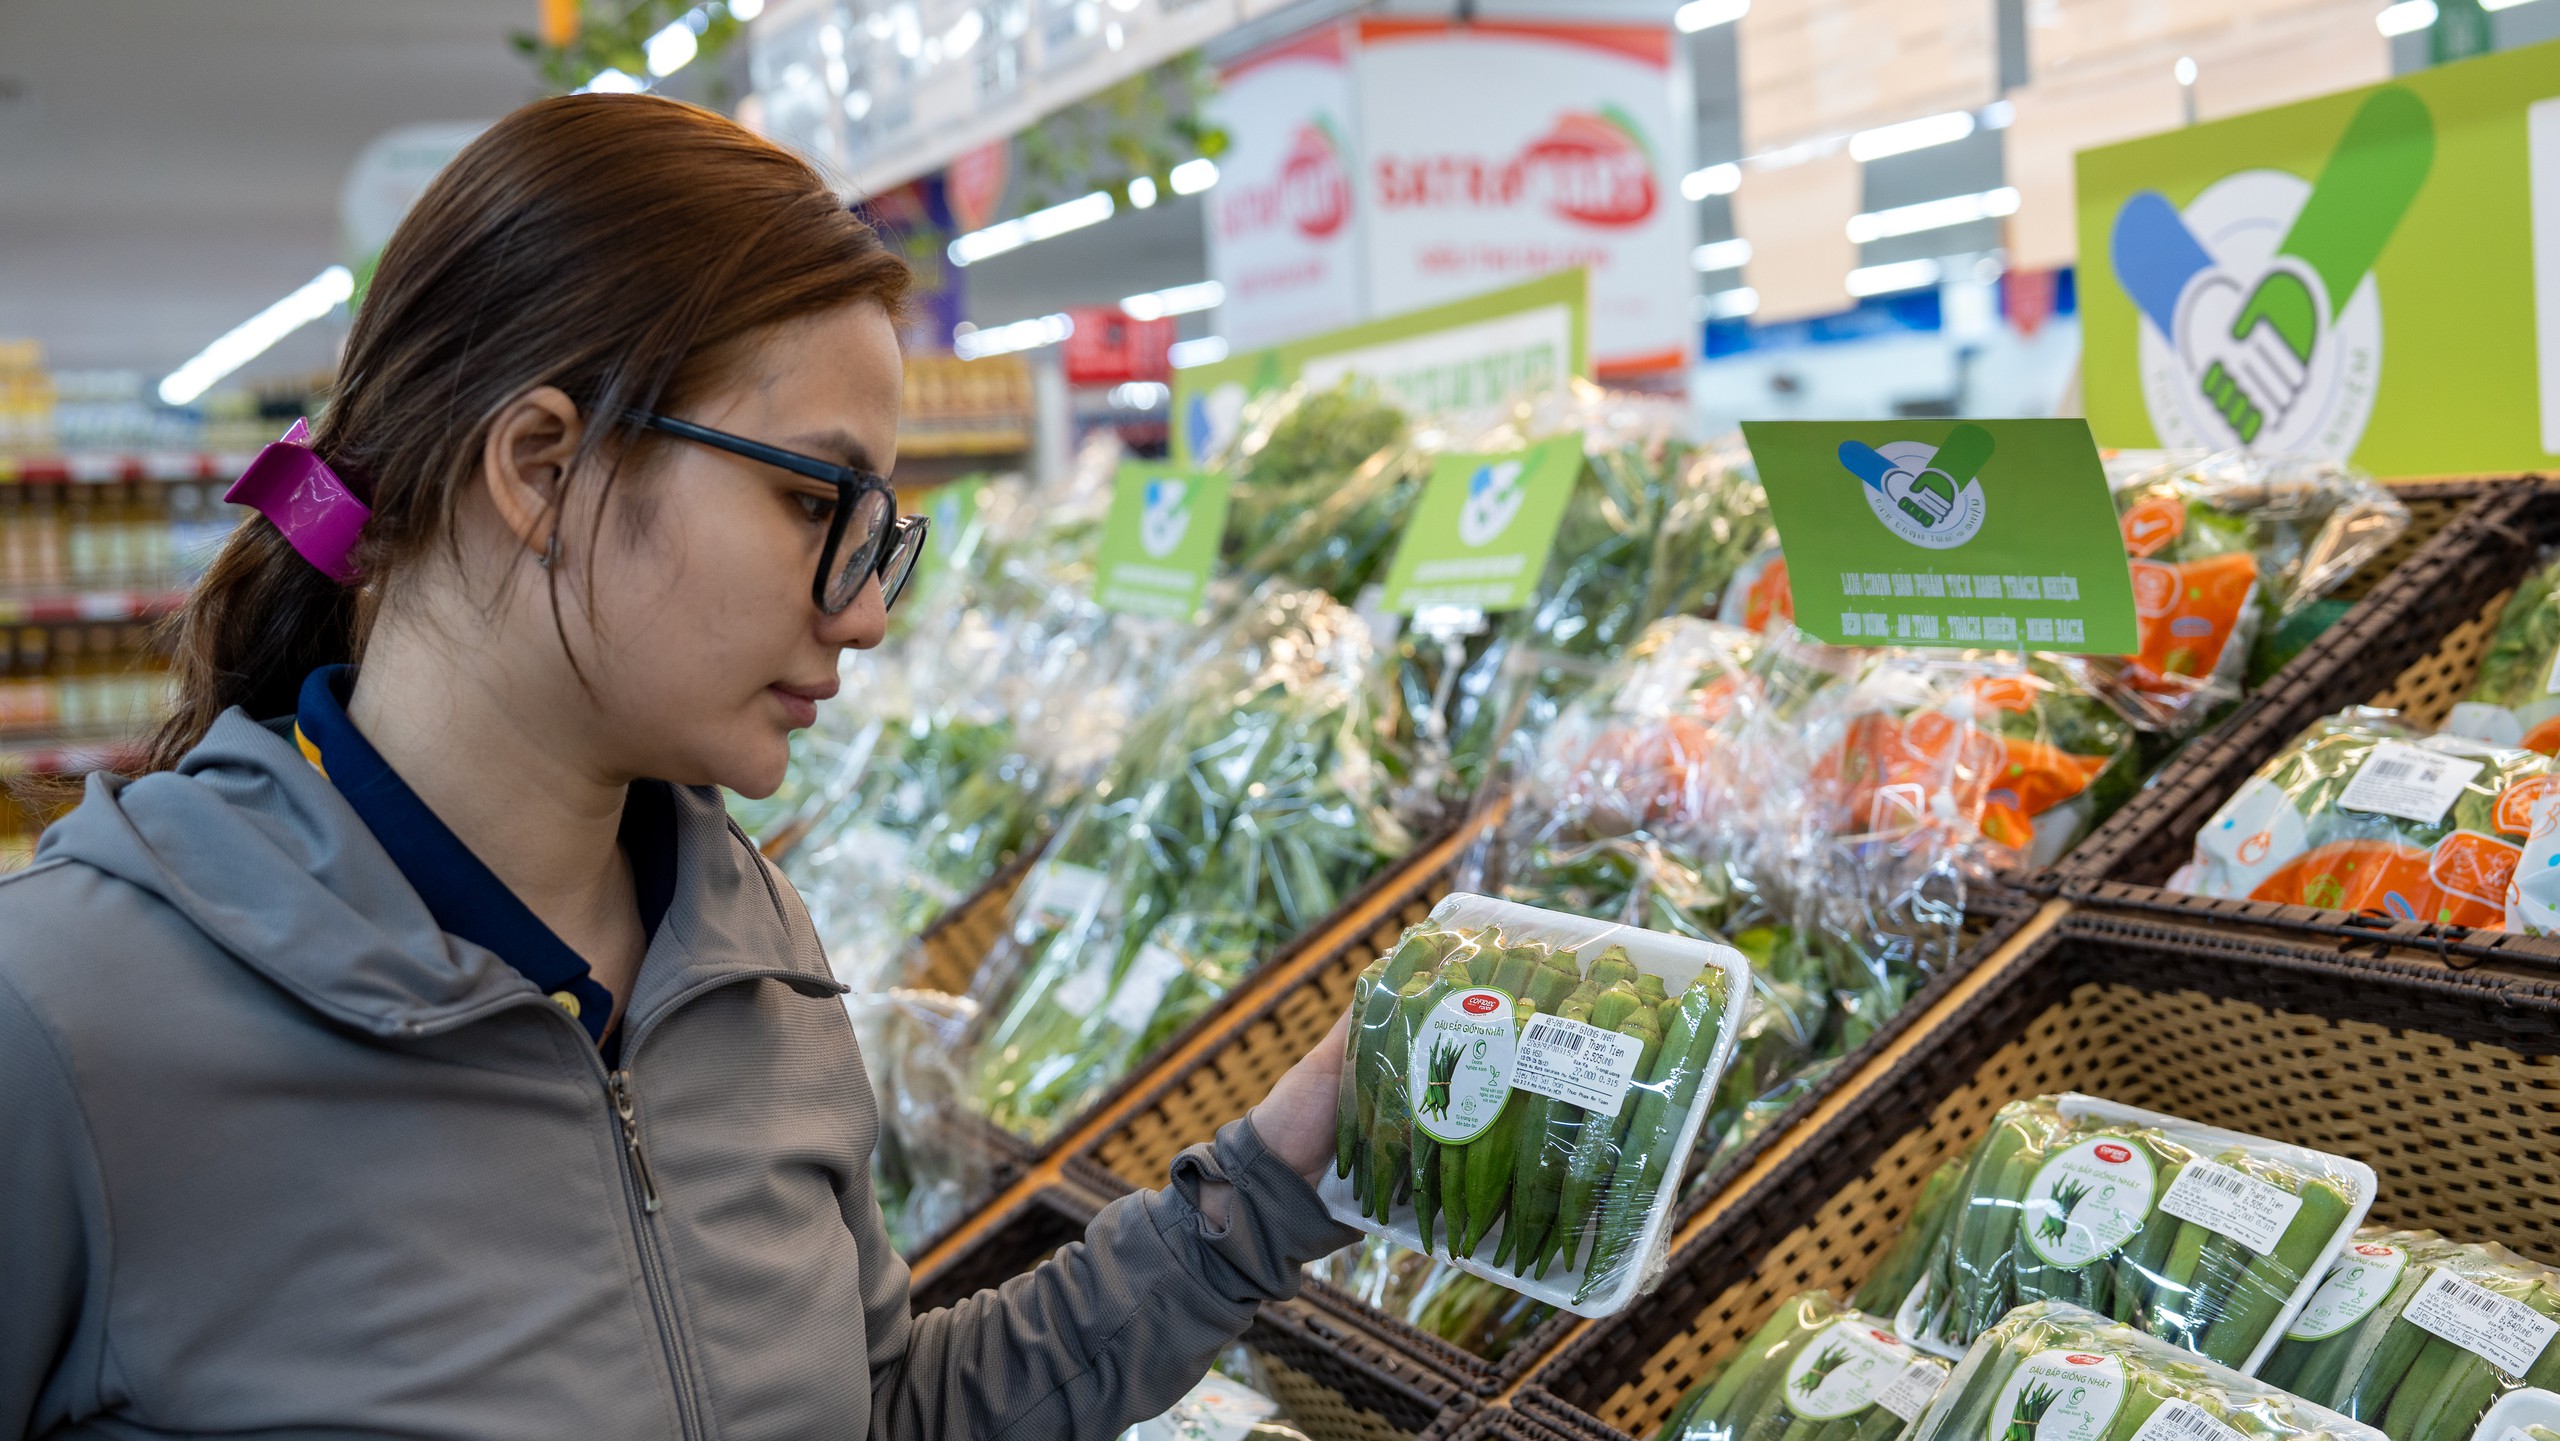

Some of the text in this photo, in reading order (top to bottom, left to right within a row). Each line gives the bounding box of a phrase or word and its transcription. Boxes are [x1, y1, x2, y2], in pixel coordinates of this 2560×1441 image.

[1579, 1025, 1599, 1039] GIONG
[1588, 1038, 1625, 1058] Thanh Tien
[1572, 1067, 1619, 1088] 27.000 0.315
[2093, 1169, 2117, 1182] GIỐNG
[2118, 1177, 2140, 1189] NHẬT
[2247, 1188, 2284, 1210] Thanh Tien
[2230, 1208, 2275, 1233] 27.000 0.315
[2504, 1306, 2545, 1334] Thanh Tien
[2485, 1327, 2534, 1357] 27.000 0.320
[2045, 1366, 2061, 1377] BẮP
[2061, 1369, 2087, 1384] GIỐNG
[2087, 1377, 2112, 1389] NHẬT
